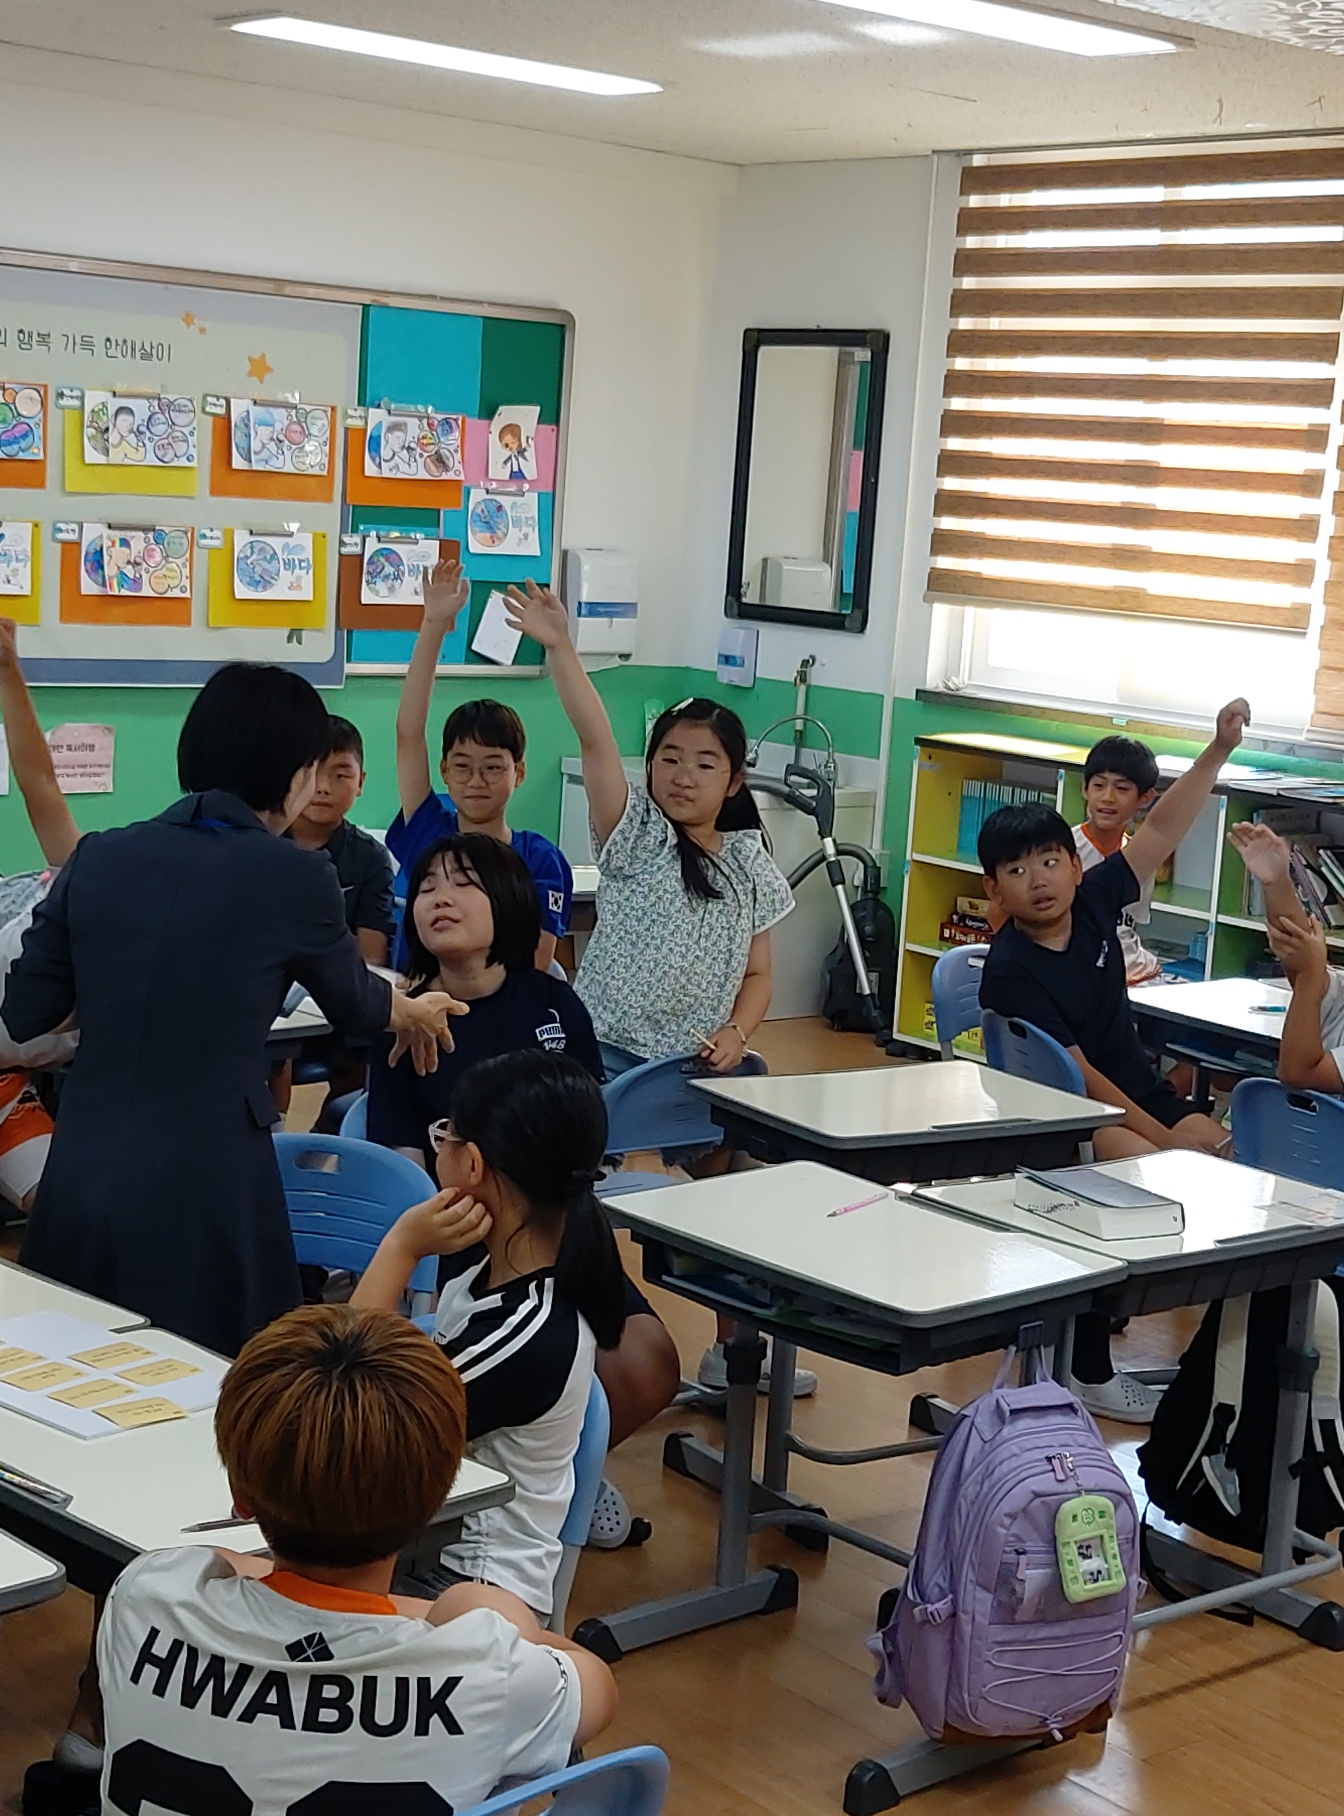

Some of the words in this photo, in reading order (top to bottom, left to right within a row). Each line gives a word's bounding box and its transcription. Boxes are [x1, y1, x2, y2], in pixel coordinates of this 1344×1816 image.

[17, 329, 52, 353] 행복
[62, 334, 96, 356] 가득
[105, 337, 172, 363] 한해살이
[282, 557, 312, 575] 바다
[129, 1626, 464, 1738] HWABUK
